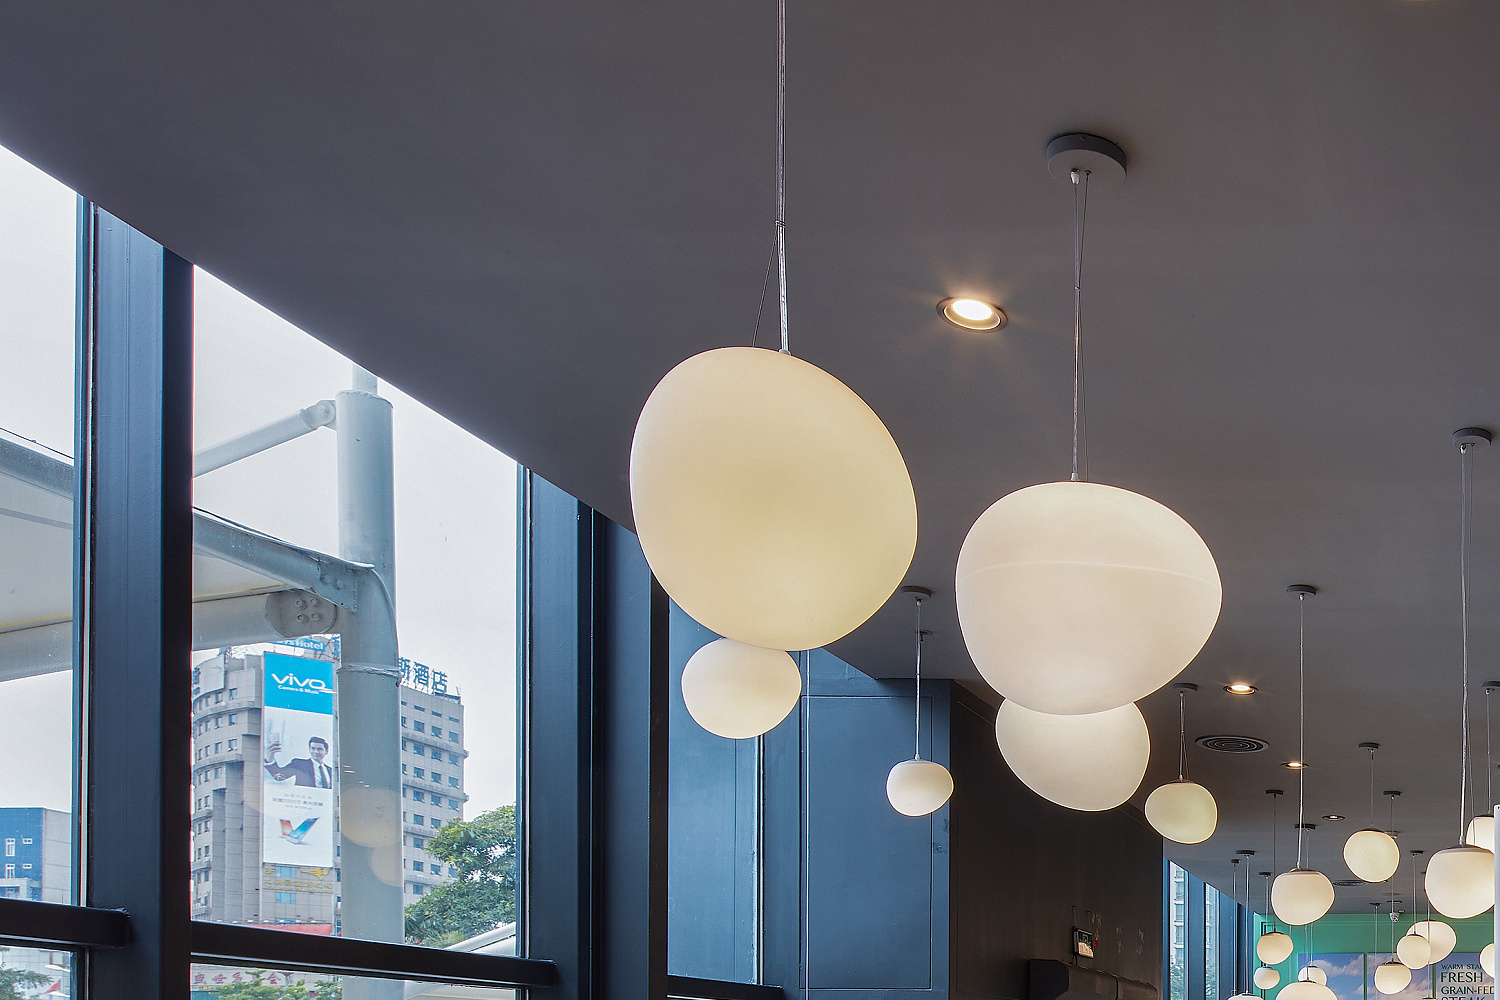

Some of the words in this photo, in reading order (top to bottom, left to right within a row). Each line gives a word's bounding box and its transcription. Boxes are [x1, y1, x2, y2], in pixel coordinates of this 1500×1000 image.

[295, 640, 323, 650] Hotel
[271, 673, 332, 692] vivo
[1441, 971, 1483, 983] FRESH
